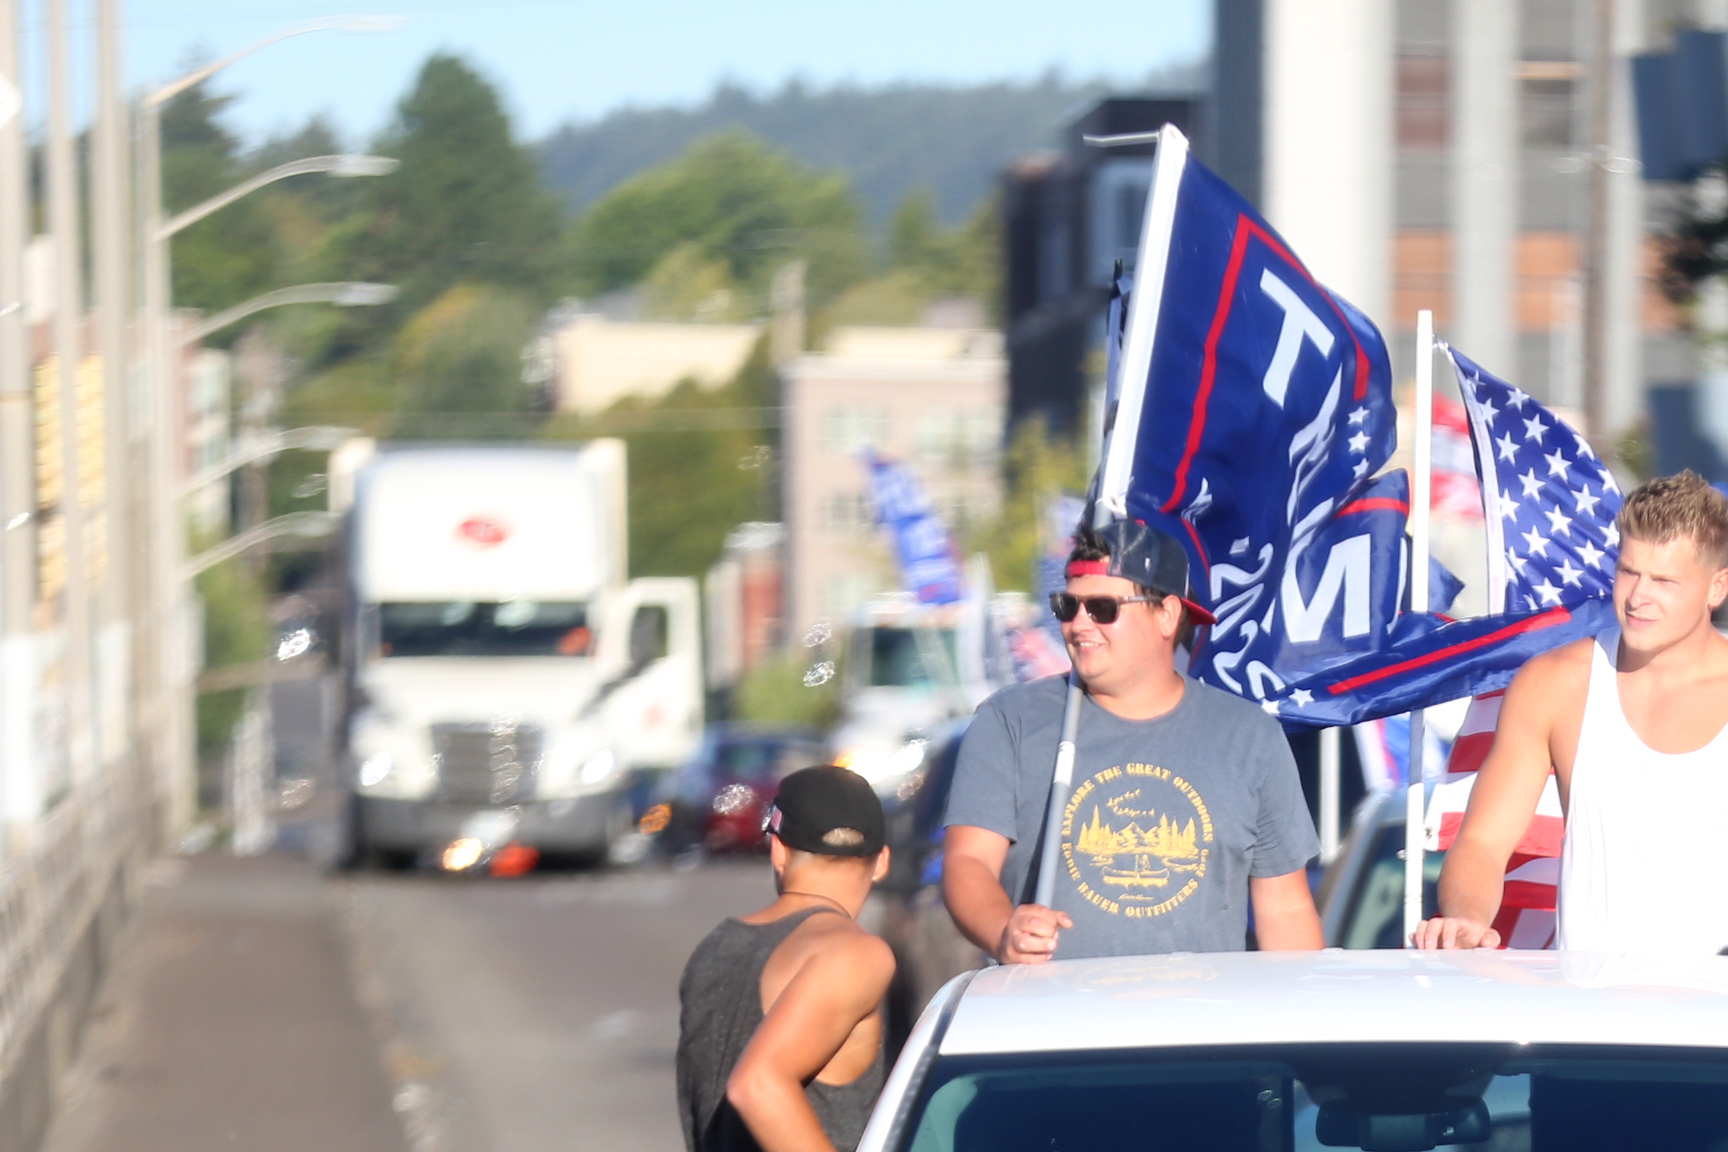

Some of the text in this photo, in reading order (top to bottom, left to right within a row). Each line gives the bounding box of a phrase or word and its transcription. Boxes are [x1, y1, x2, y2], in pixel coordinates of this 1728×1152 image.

[1061, 762, 1214, 842] EXPLORE THE GREAT OUTDOORS
[1077, 882, 1120, 914] BAUER
[1125, 878, 1198, 918] OUTFITTERS
